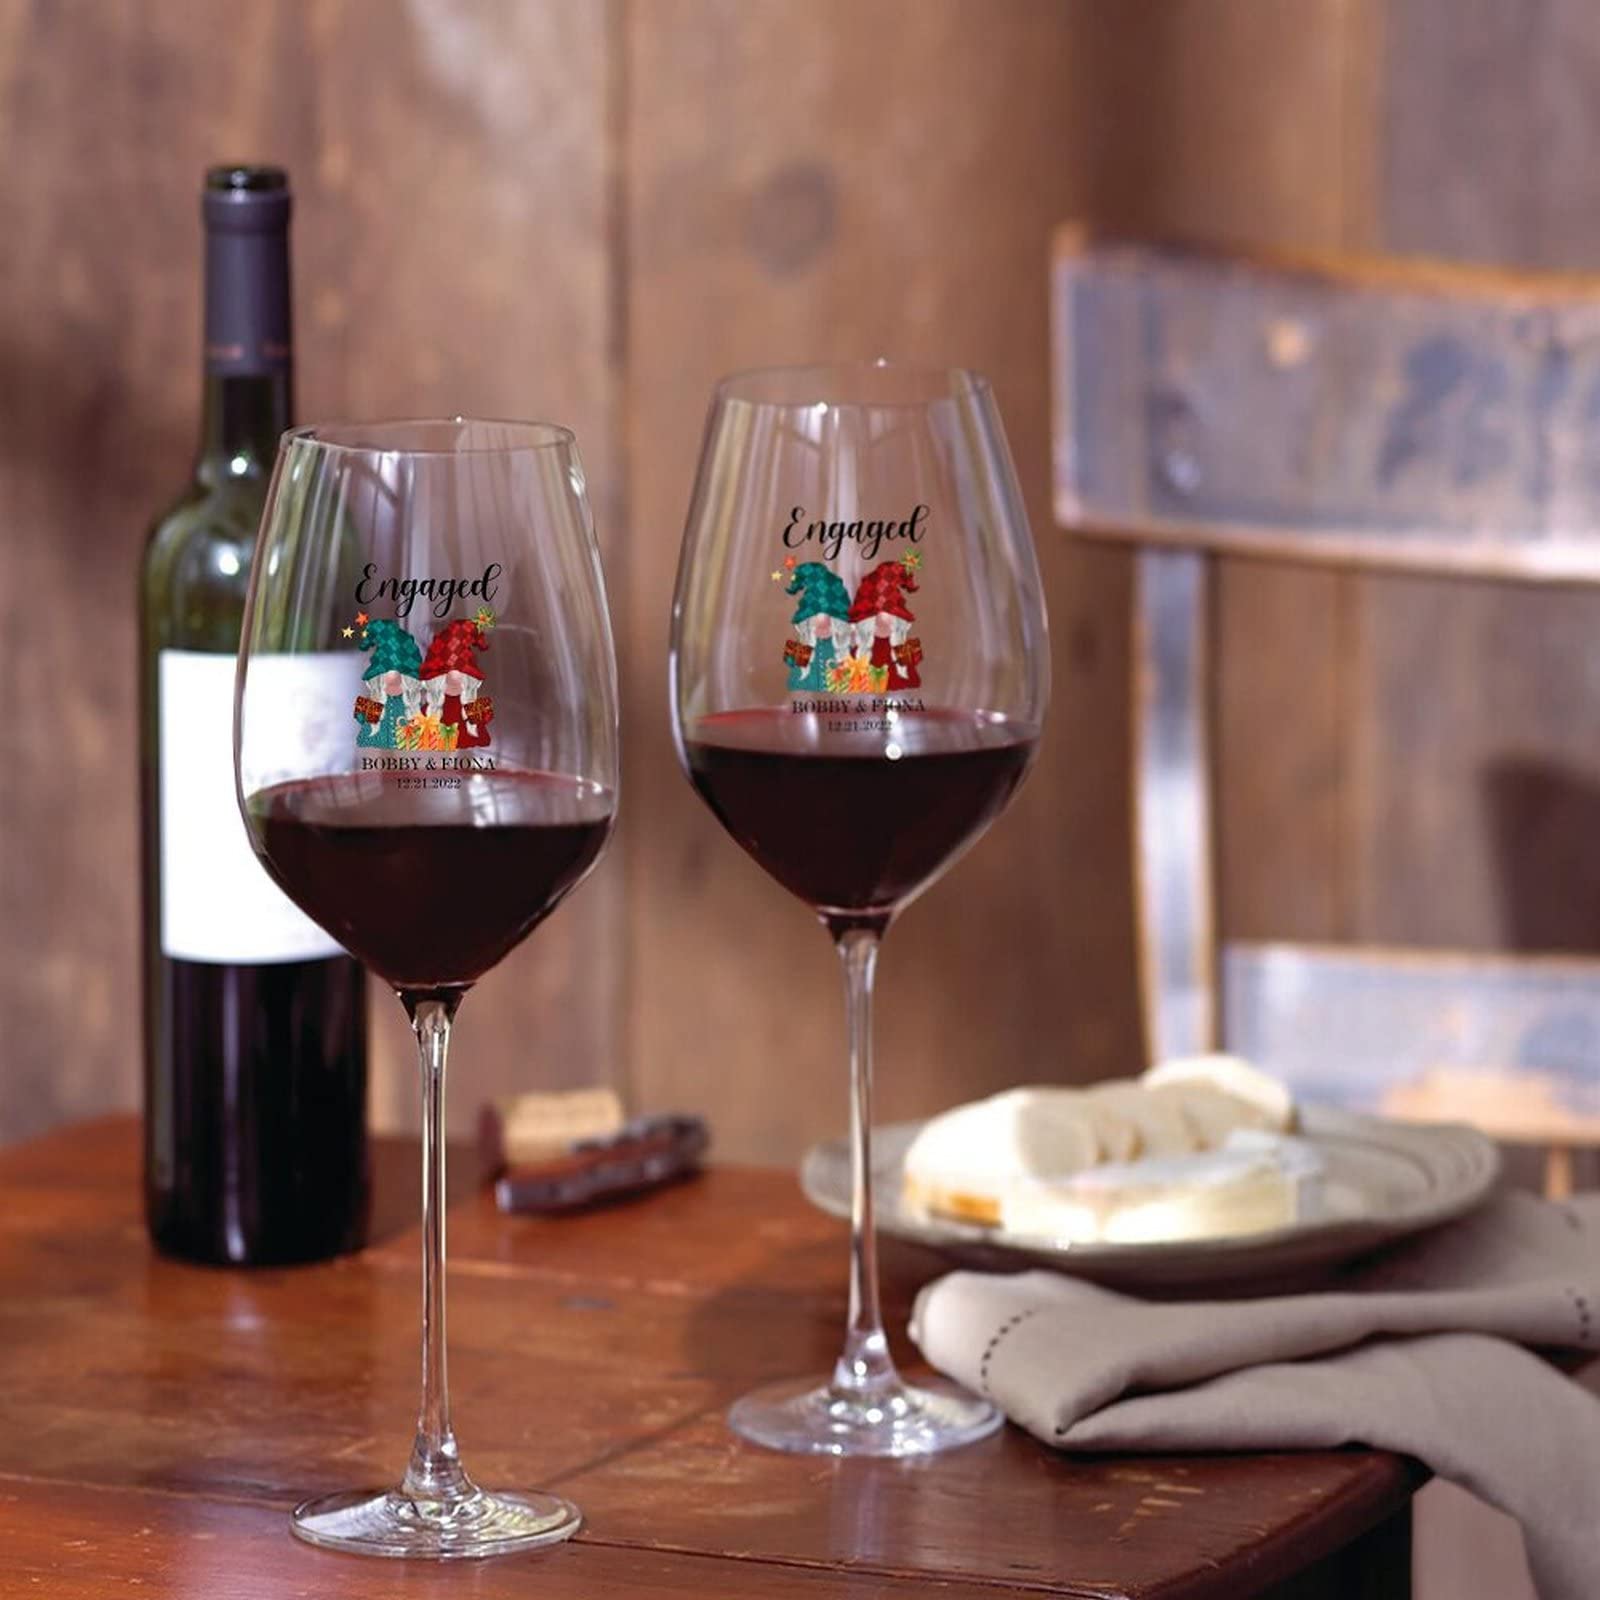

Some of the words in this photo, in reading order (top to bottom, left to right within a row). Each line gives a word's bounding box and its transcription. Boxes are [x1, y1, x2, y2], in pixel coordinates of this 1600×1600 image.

[783, 503, 931, 561] Engaged
[354, 562, 502, 618] Engaged
[792, 699, 852, 714] BOBBY
[855, 698, 868, 712] &
[871, 698, 926, 712] FIONA
[361, 757, 422, 771] BOBBY
[425, 757, 437, 771] &
[441, 757, 497, 771] FIONA
[396, 778, 461, 790] 12.21.2022
